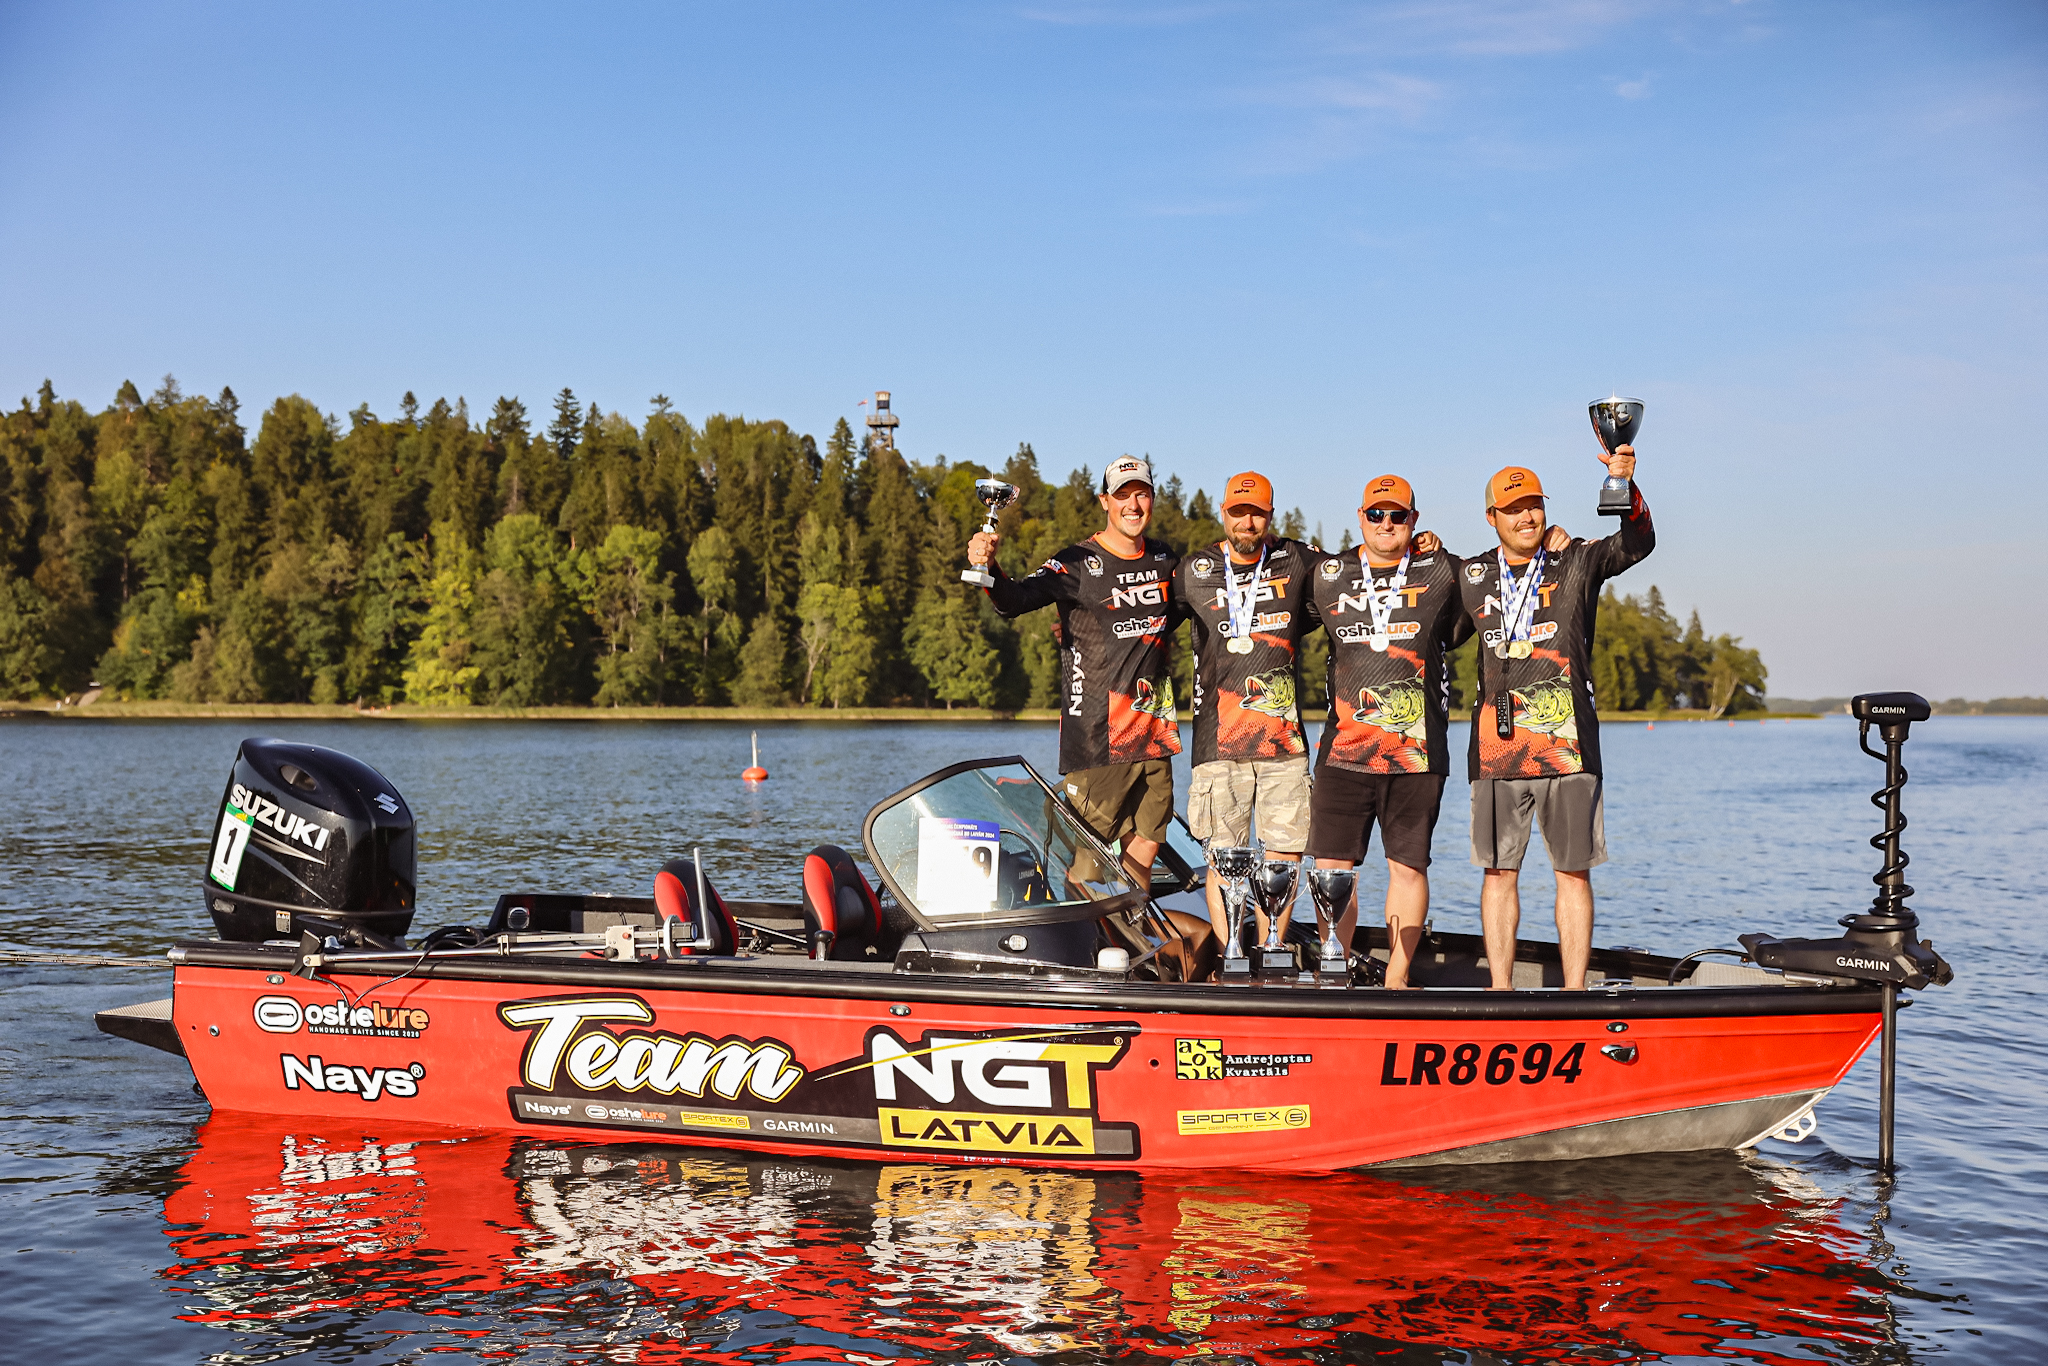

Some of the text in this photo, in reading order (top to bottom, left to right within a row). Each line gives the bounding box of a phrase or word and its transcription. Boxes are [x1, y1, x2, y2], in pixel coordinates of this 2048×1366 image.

[1116, 570, 1158, 584] TEAM
[1224, 568, 1272, 582] EAM
[1111, 581, 1170, 608] NGT
[1338, 587, 1429, 613] NGT
[1484, 583, 1559, 615] NT
[1219, 612, 1290, 632] oelure
[1485, 622, 1556, 641] osure
[1871, 705, 1906, 715] GARMIN
[230, 783, 330, 851] SUZUKI
[223, 827, 238, 866] 1
[1836, 956, 1890, 971] GARMIN
[305, 1001, 429, 1030] oshelure
[309, 1026, 349, 1035] HANDMADE
[352, 1028, 374, 1036] BAITS
[377, 1029, 400, 1037] SINCE
[503, 1000, 802, 1102] Team
[1226, 1054, 1312, 1065] Andrejostas
[1380, 1042, 1586, 1086] LR8694
[609, 1107, 667, 1120] oshelure
[683, 1113, 734, 1123] SPORTEX
[1181, 1111, 1280, 1125] SPORTEX
[891, 1115, 1084, 1146] LATVIA
